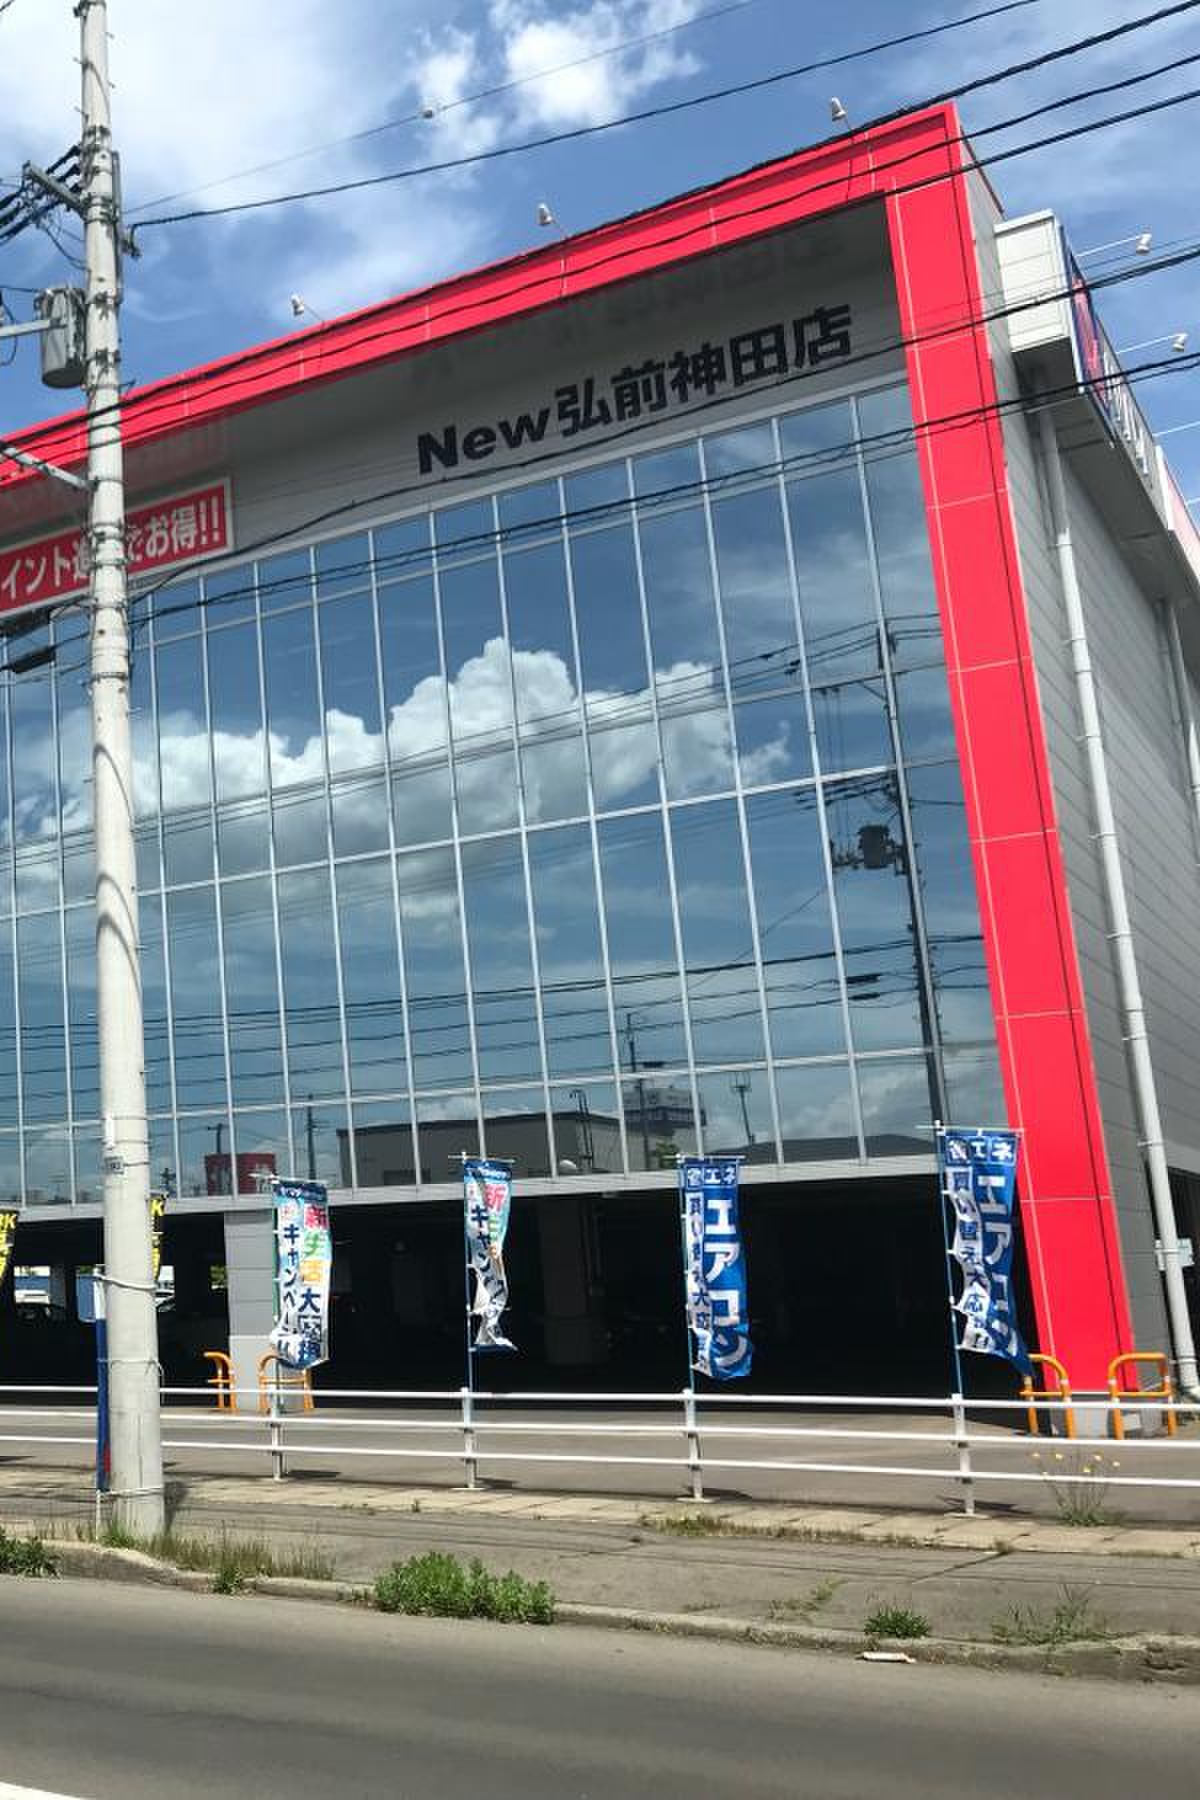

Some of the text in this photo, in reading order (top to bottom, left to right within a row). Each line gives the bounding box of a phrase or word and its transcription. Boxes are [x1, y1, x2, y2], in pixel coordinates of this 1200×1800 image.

[416, 303, 852, 475] New弘前神田店
[703, 1198, 748, 1367] エアコン
